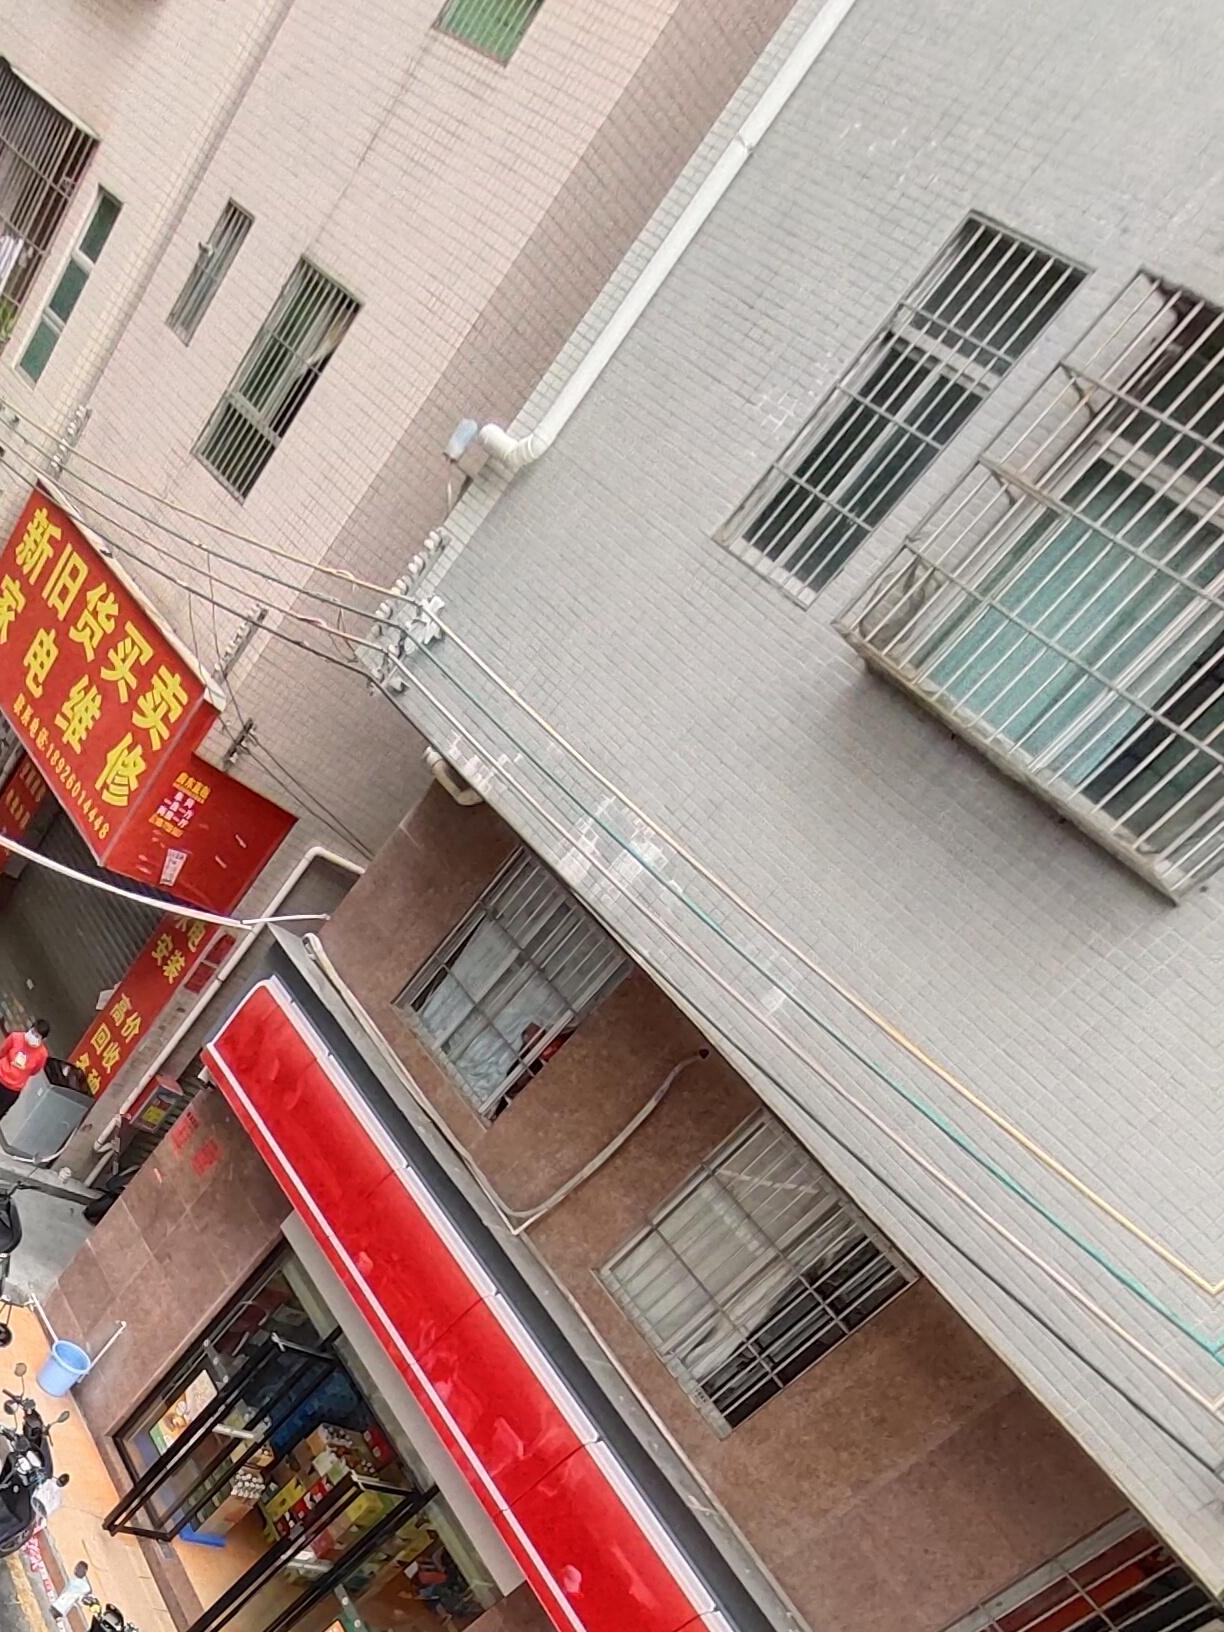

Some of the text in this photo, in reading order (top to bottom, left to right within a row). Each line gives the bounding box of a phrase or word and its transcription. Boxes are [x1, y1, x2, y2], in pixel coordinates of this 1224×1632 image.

[15, 507, 189, 751] 新旧货买卖
[152, 933, 185, 984] 安装
[109, 993, 141, 1043] 高价
[90, 1023, 121, 1074] 回收
